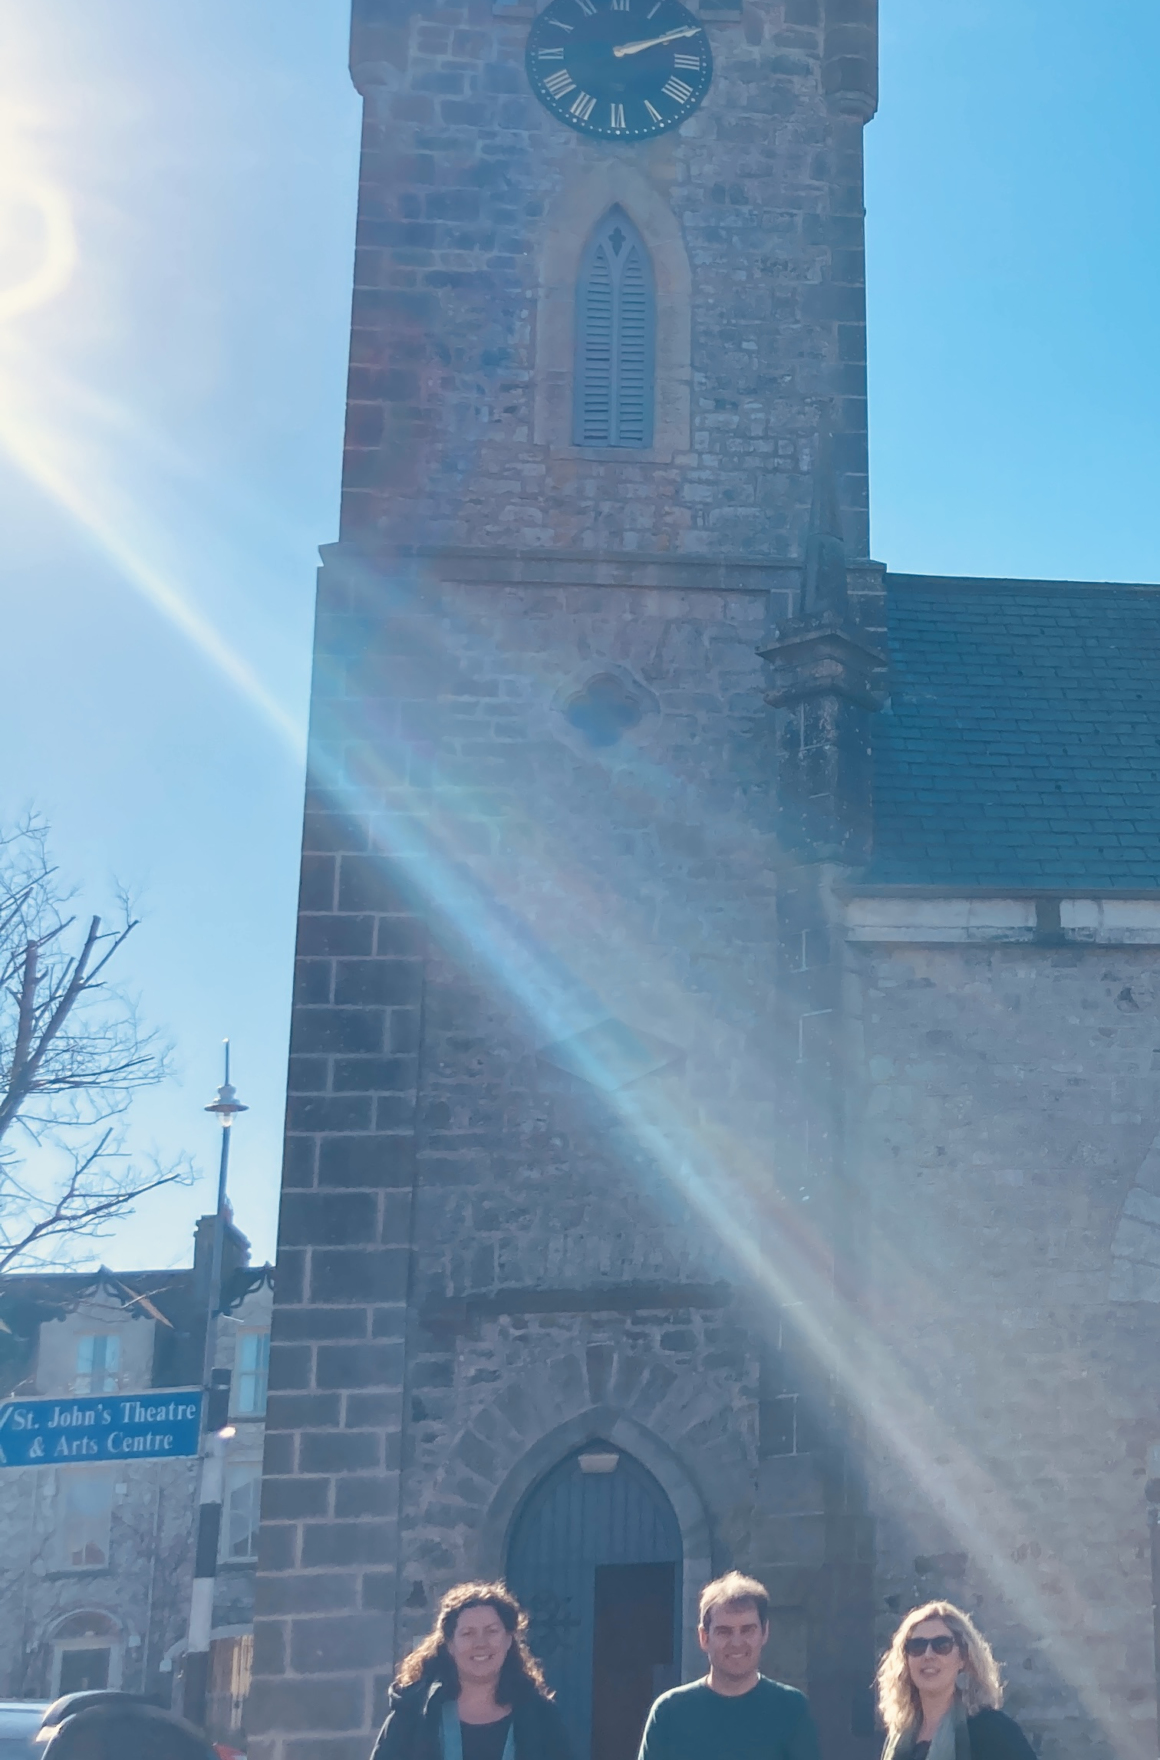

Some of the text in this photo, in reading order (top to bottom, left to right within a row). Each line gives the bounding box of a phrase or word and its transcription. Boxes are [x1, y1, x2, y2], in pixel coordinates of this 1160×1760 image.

[12, 1401, 196, 1430] St. John's Theatre
[29, 1431, 173, 1458] & Arts Centre
